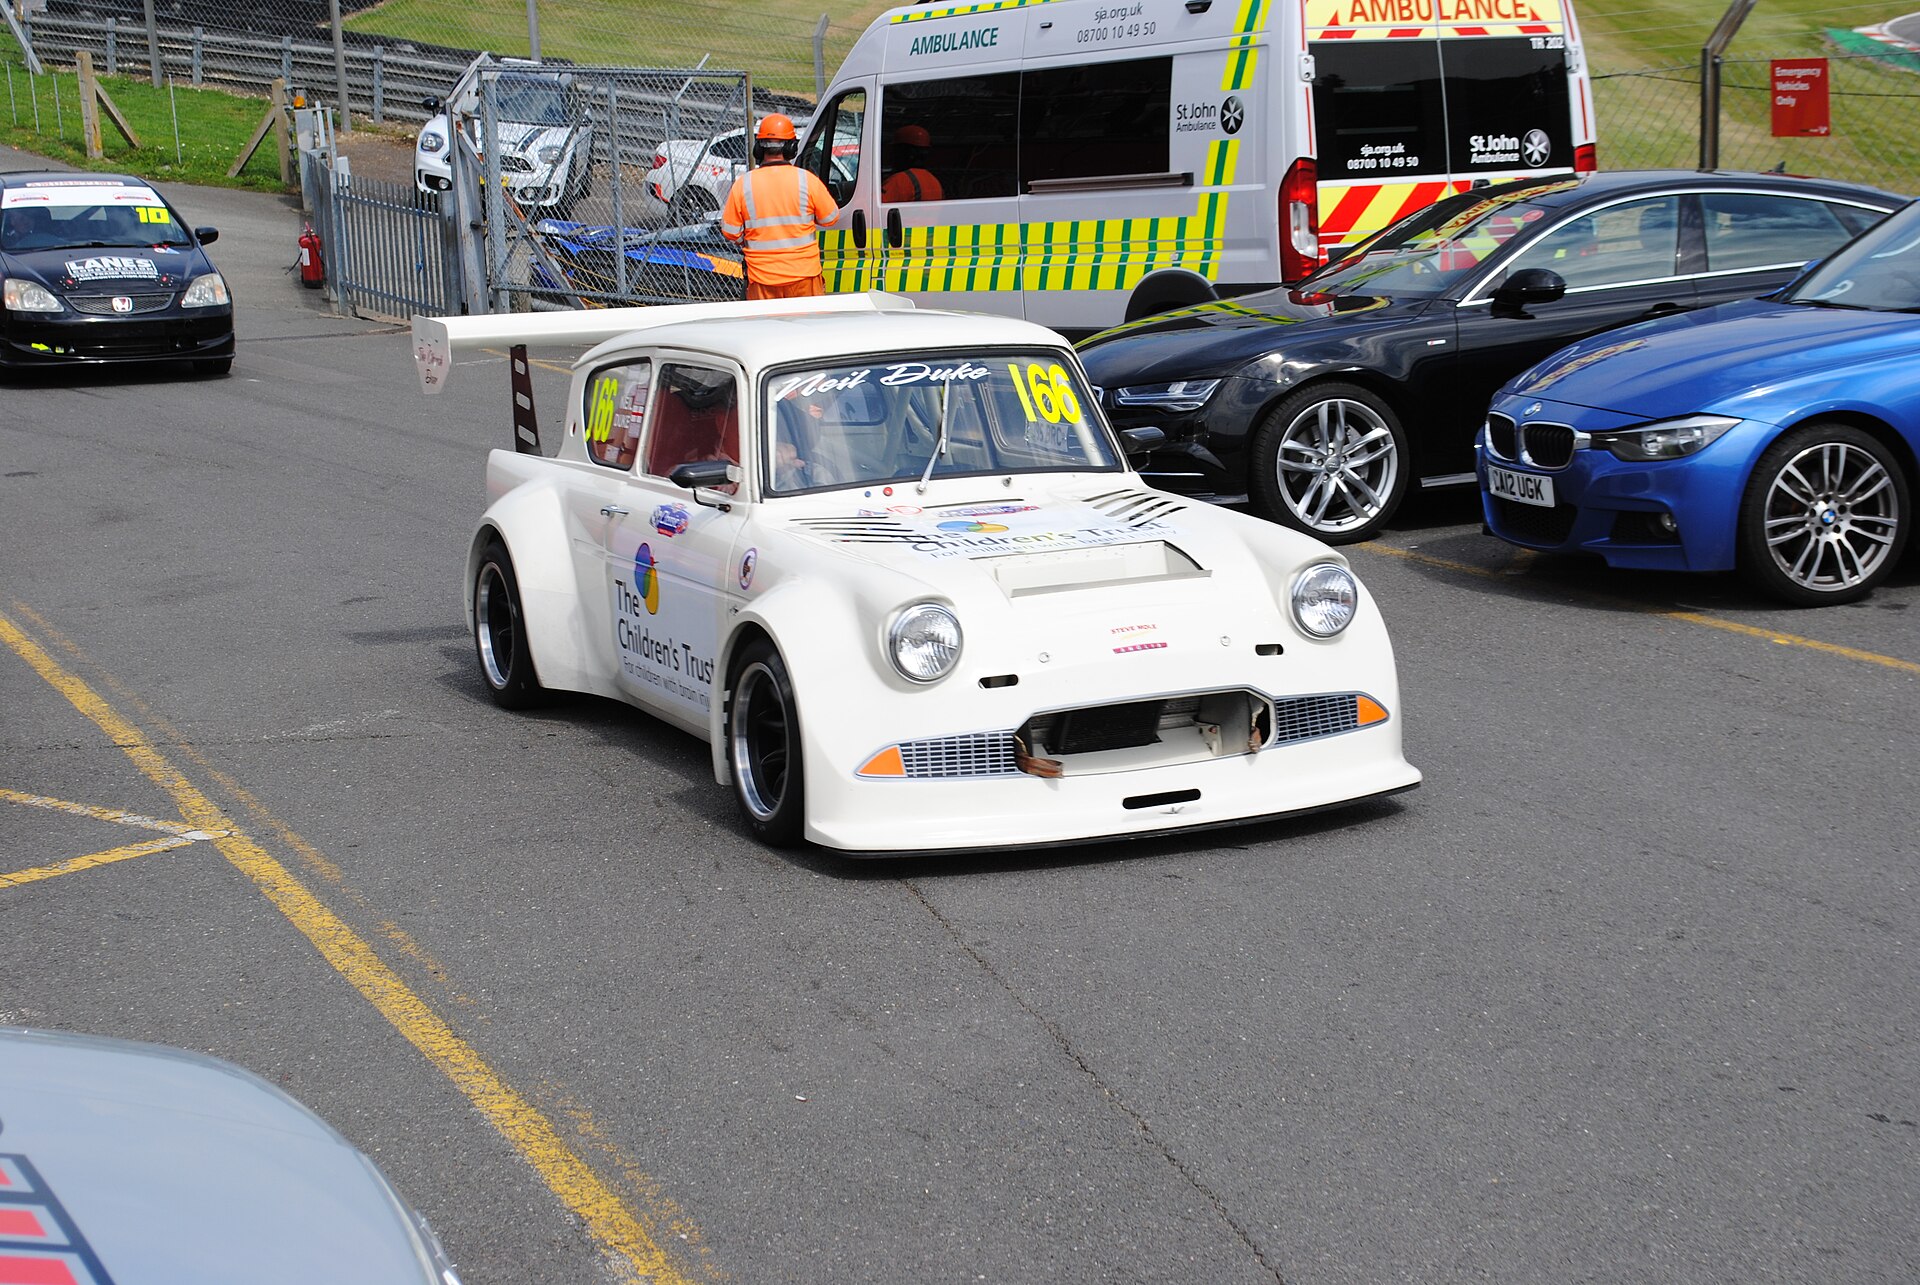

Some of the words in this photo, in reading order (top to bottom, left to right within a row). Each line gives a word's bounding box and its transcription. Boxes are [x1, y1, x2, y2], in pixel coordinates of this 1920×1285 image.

[1094, 2, 1143, 23] sja.org.uk
[1349, 0, 1527, 22] AMBULANCE
[909, 27, 999, 56] AMBULANCE
[1077, 30, 1107, 44] 08700
[1112, 27, 1125, 40] 10
[1127, 25, 1142, 39] 49
[1143, 22, 1157, 37] 50
[1529, 38, 1545, 50] TR
[1775, 67, 1821, 78] Emergency
[1775, 81, 1810, 91] Vehicles
[1775, 96, 1797, 107] Only
[1177, 104, 1188, 120] St
[1189, 102, 1217, 120] John
[1176, 120, 1217, 133] Ambulance
[1360, 143, 1405, 156] sja.org.uk
[1470, 136, 1485, 152] St
[1485, 135, 1519, 151] John
[1347, 159, 1376, 170] 08700
[1379, 158, 1391, 169] 10
[1392, 157, 1405, 168] 49
[1406, 156, 1419, 167] 50
[1470, 152, 1520, 164] Ambulance
[135, 207, 170, 224] 10
[69, 256, 152, 270] LANES
[776, 369, 871, 401] Neil
[879, 362, 991, 386] Duke
[1007, 363, 1081, 424] 166
[585, 377, 618, 442] 166
[1493, 469, 1516, 496] CA12
[1517, 476, 1545, 501] UGK
[911, 531, 1076, 552] Children's
[1077, 521, 1169, 538] Trust
[615, 579, 640, 617] The
[1111, 626, 1135, 635] STEVE
[618, 618, 680, 672] Children's
[681, 643, 715, 685] Trust
[623, 656, 634, 675] For
[635, 662, 662, 687] children
[662, 674, 678, 695] with
[679, 679, 698, 703] brain
